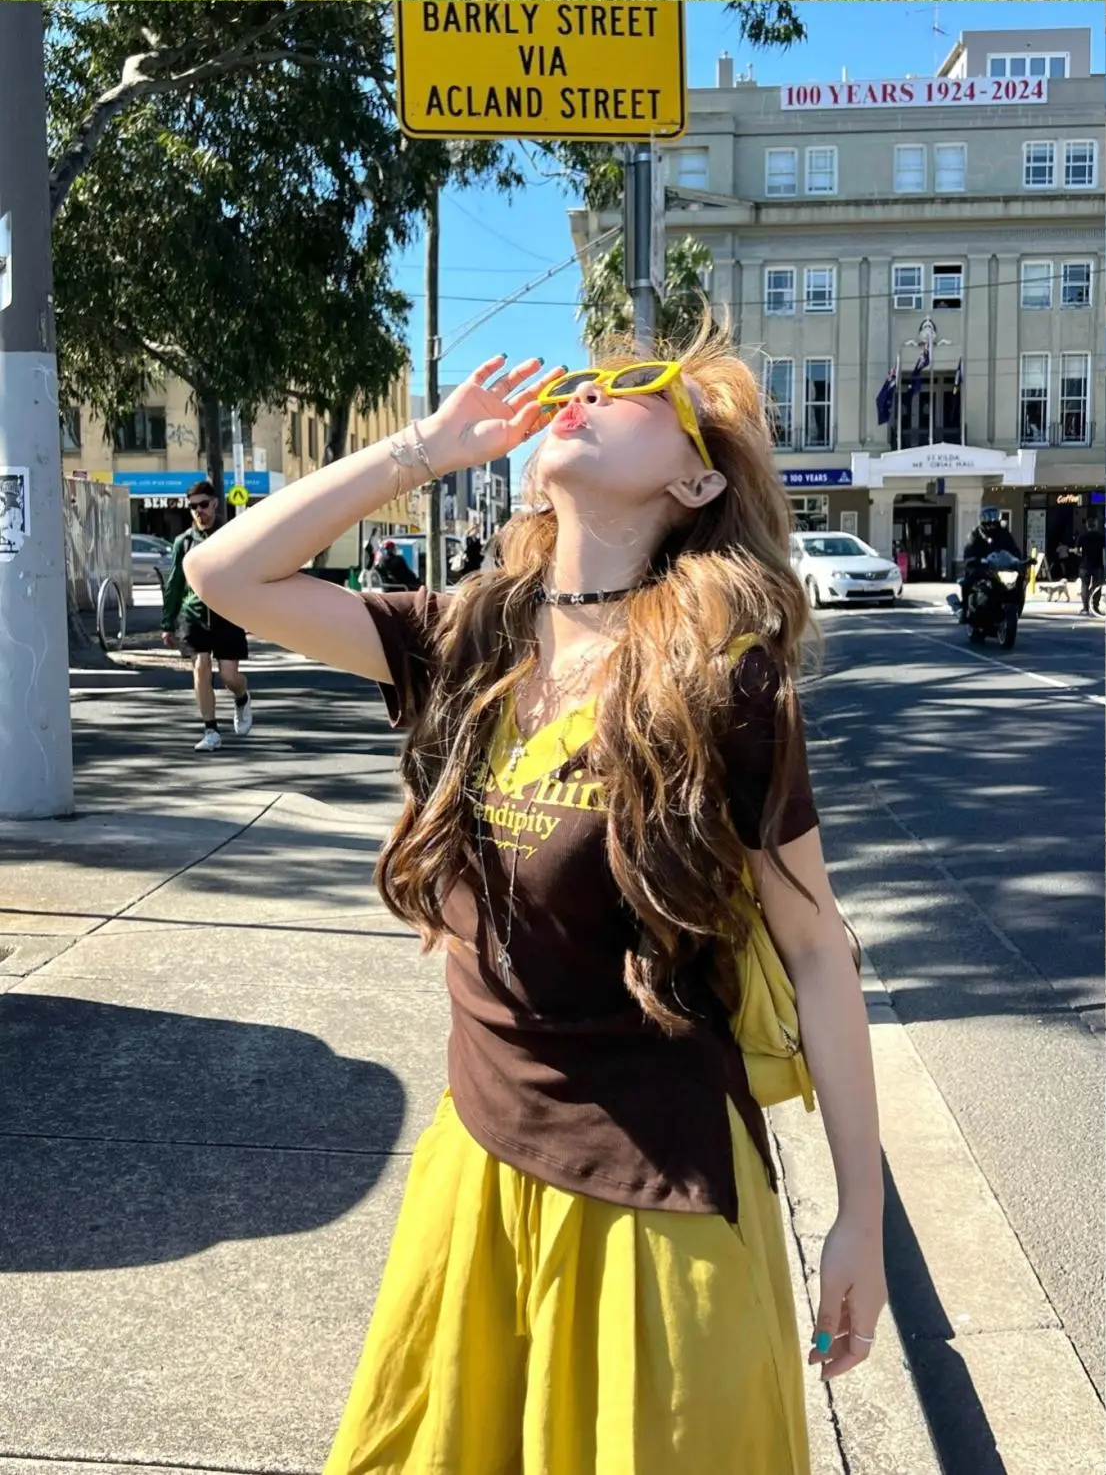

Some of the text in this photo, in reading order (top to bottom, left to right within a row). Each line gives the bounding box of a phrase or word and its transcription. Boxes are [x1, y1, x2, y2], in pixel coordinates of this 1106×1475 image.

[422, 1, 658, 37] BARKLY STREET
[518, 45, 568, 77] VIA
[426, 85, 661, 120] ACLAND STREET
[786, 85, 821, 107] 100
[828, 83, 915, 105] YEARS
[804, 474, 828, 482] YEARS
[143, 498, 168, 509] BEN
